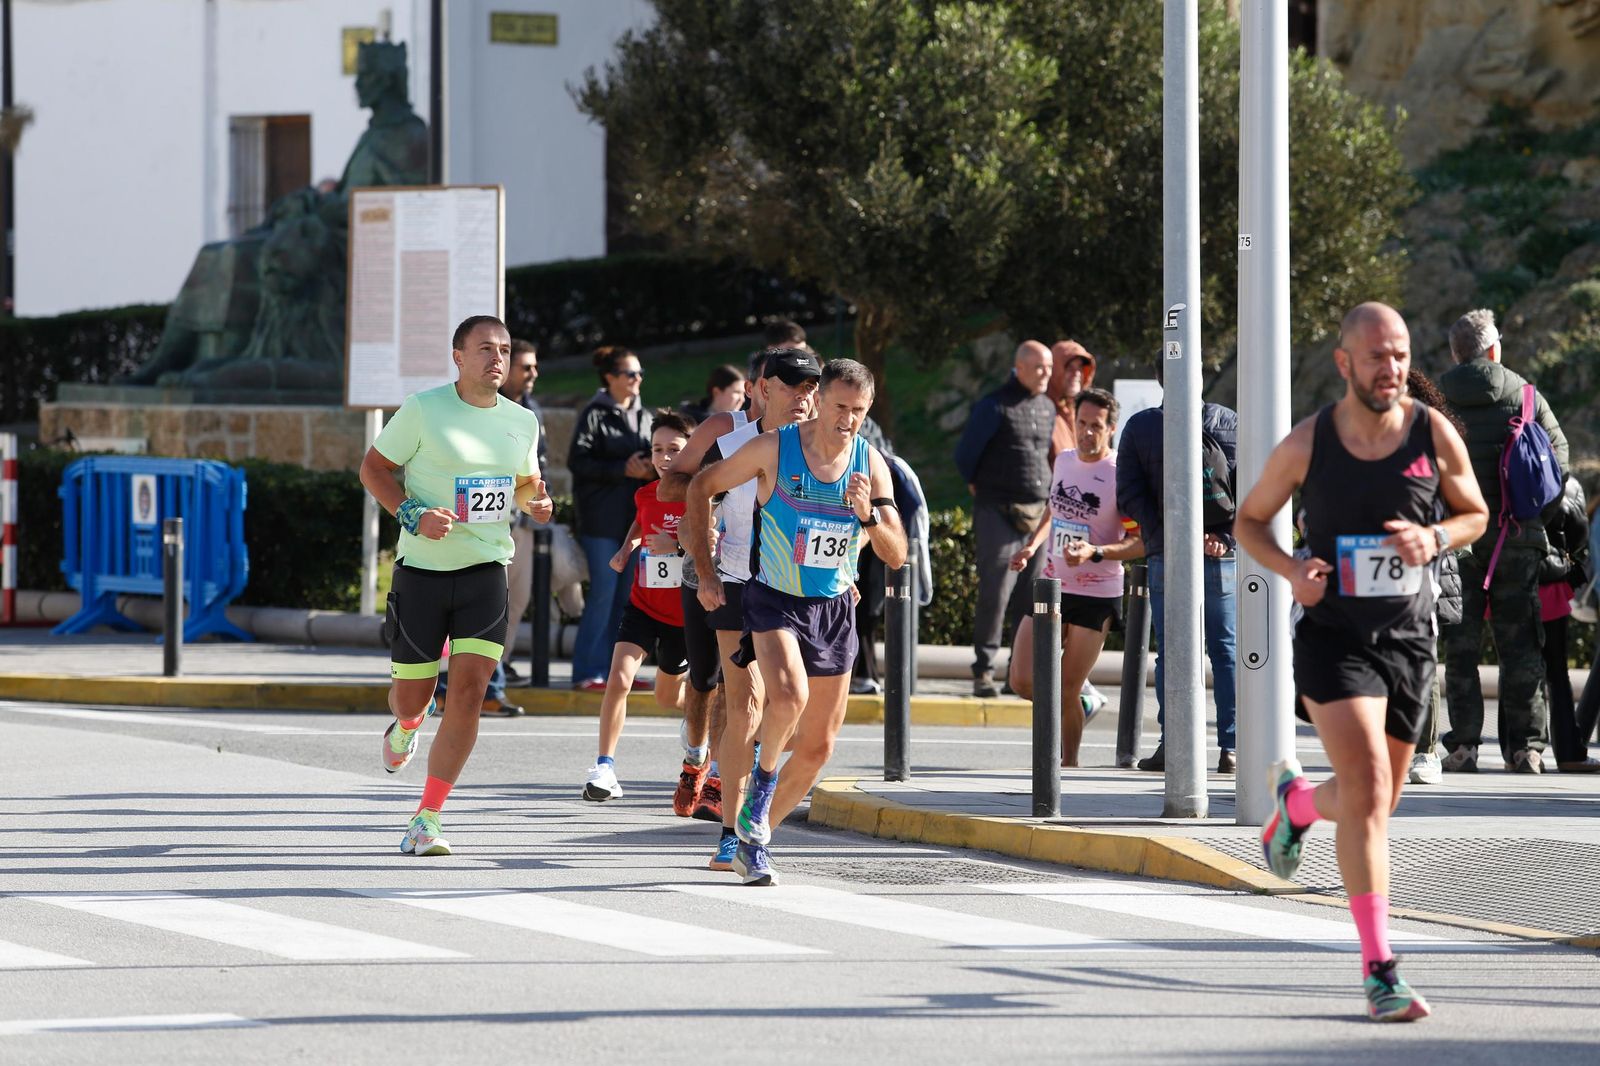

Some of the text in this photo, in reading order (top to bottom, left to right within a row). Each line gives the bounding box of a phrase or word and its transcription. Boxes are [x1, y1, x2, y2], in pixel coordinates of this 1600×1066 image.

[472, 478, 510, 486] CARRERA
[471, 492, 505, 512] 223
[800, 518, 811, 526] III
[811, 535, 848, 557] 138
[658, 562, 668, 578] 8
[1369, 556, 1404, 580] 78
